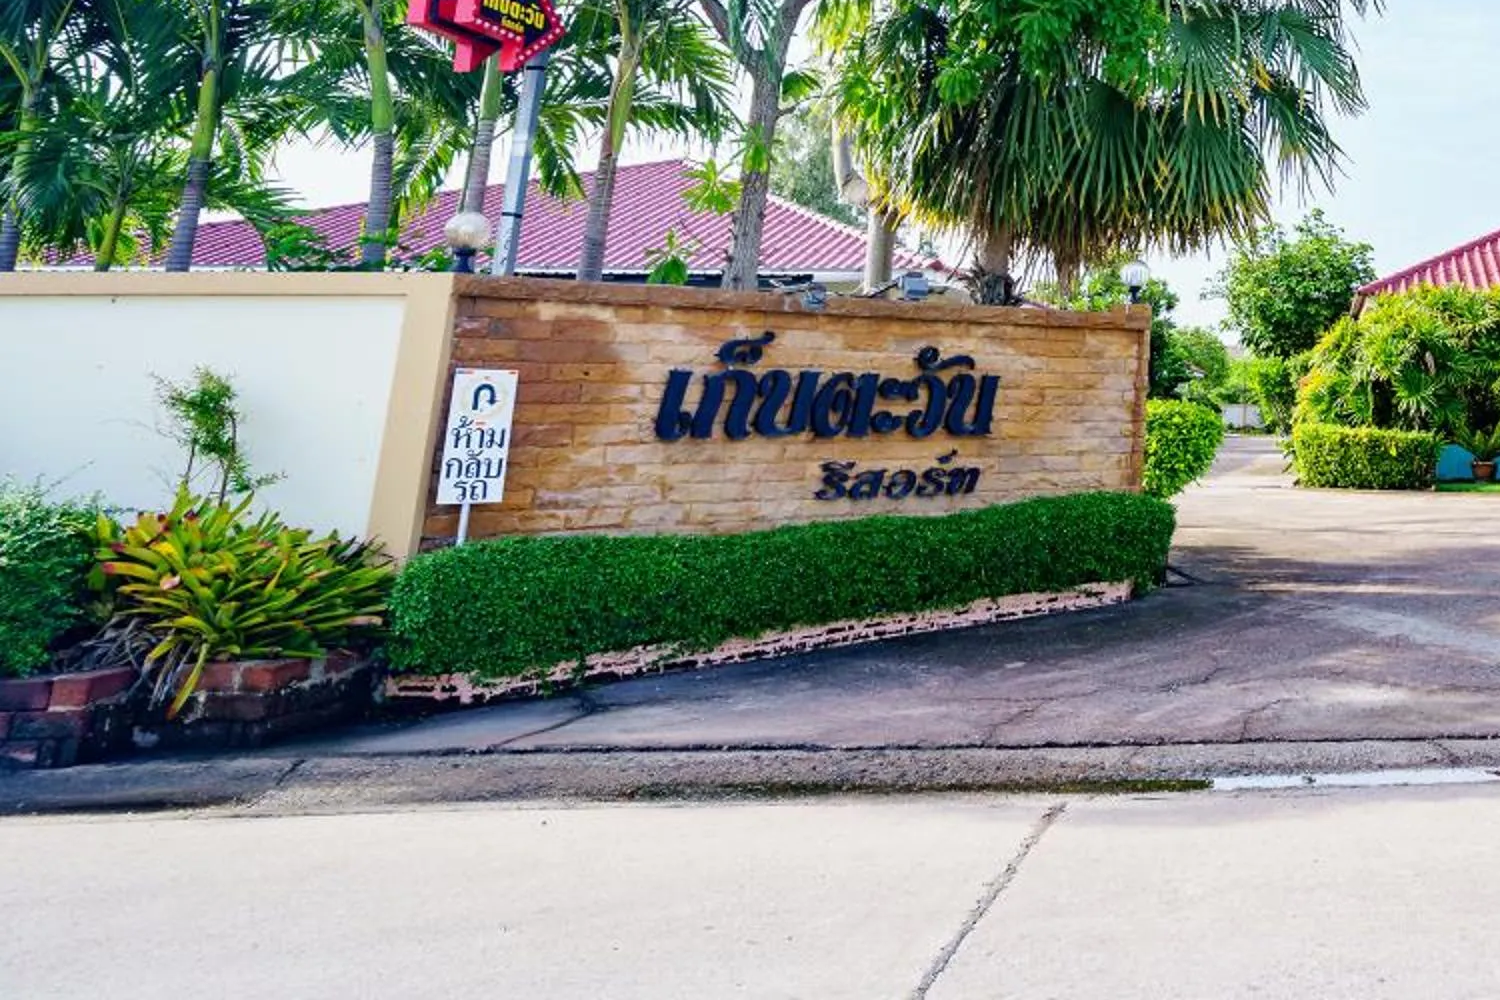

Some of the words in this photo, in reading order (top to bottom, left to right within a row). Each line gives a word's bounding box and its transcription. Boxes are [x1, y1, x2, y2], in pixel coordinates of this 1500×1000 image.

[653, 330, 1001, 441] เก็บตะวัน
[452, 415, 506, 449] ห้าม
[445, 450, 503, 479] กลับ
[814, 448, 981, 501] รีสอร์ท
[454, 479, 487, 501] รถ
